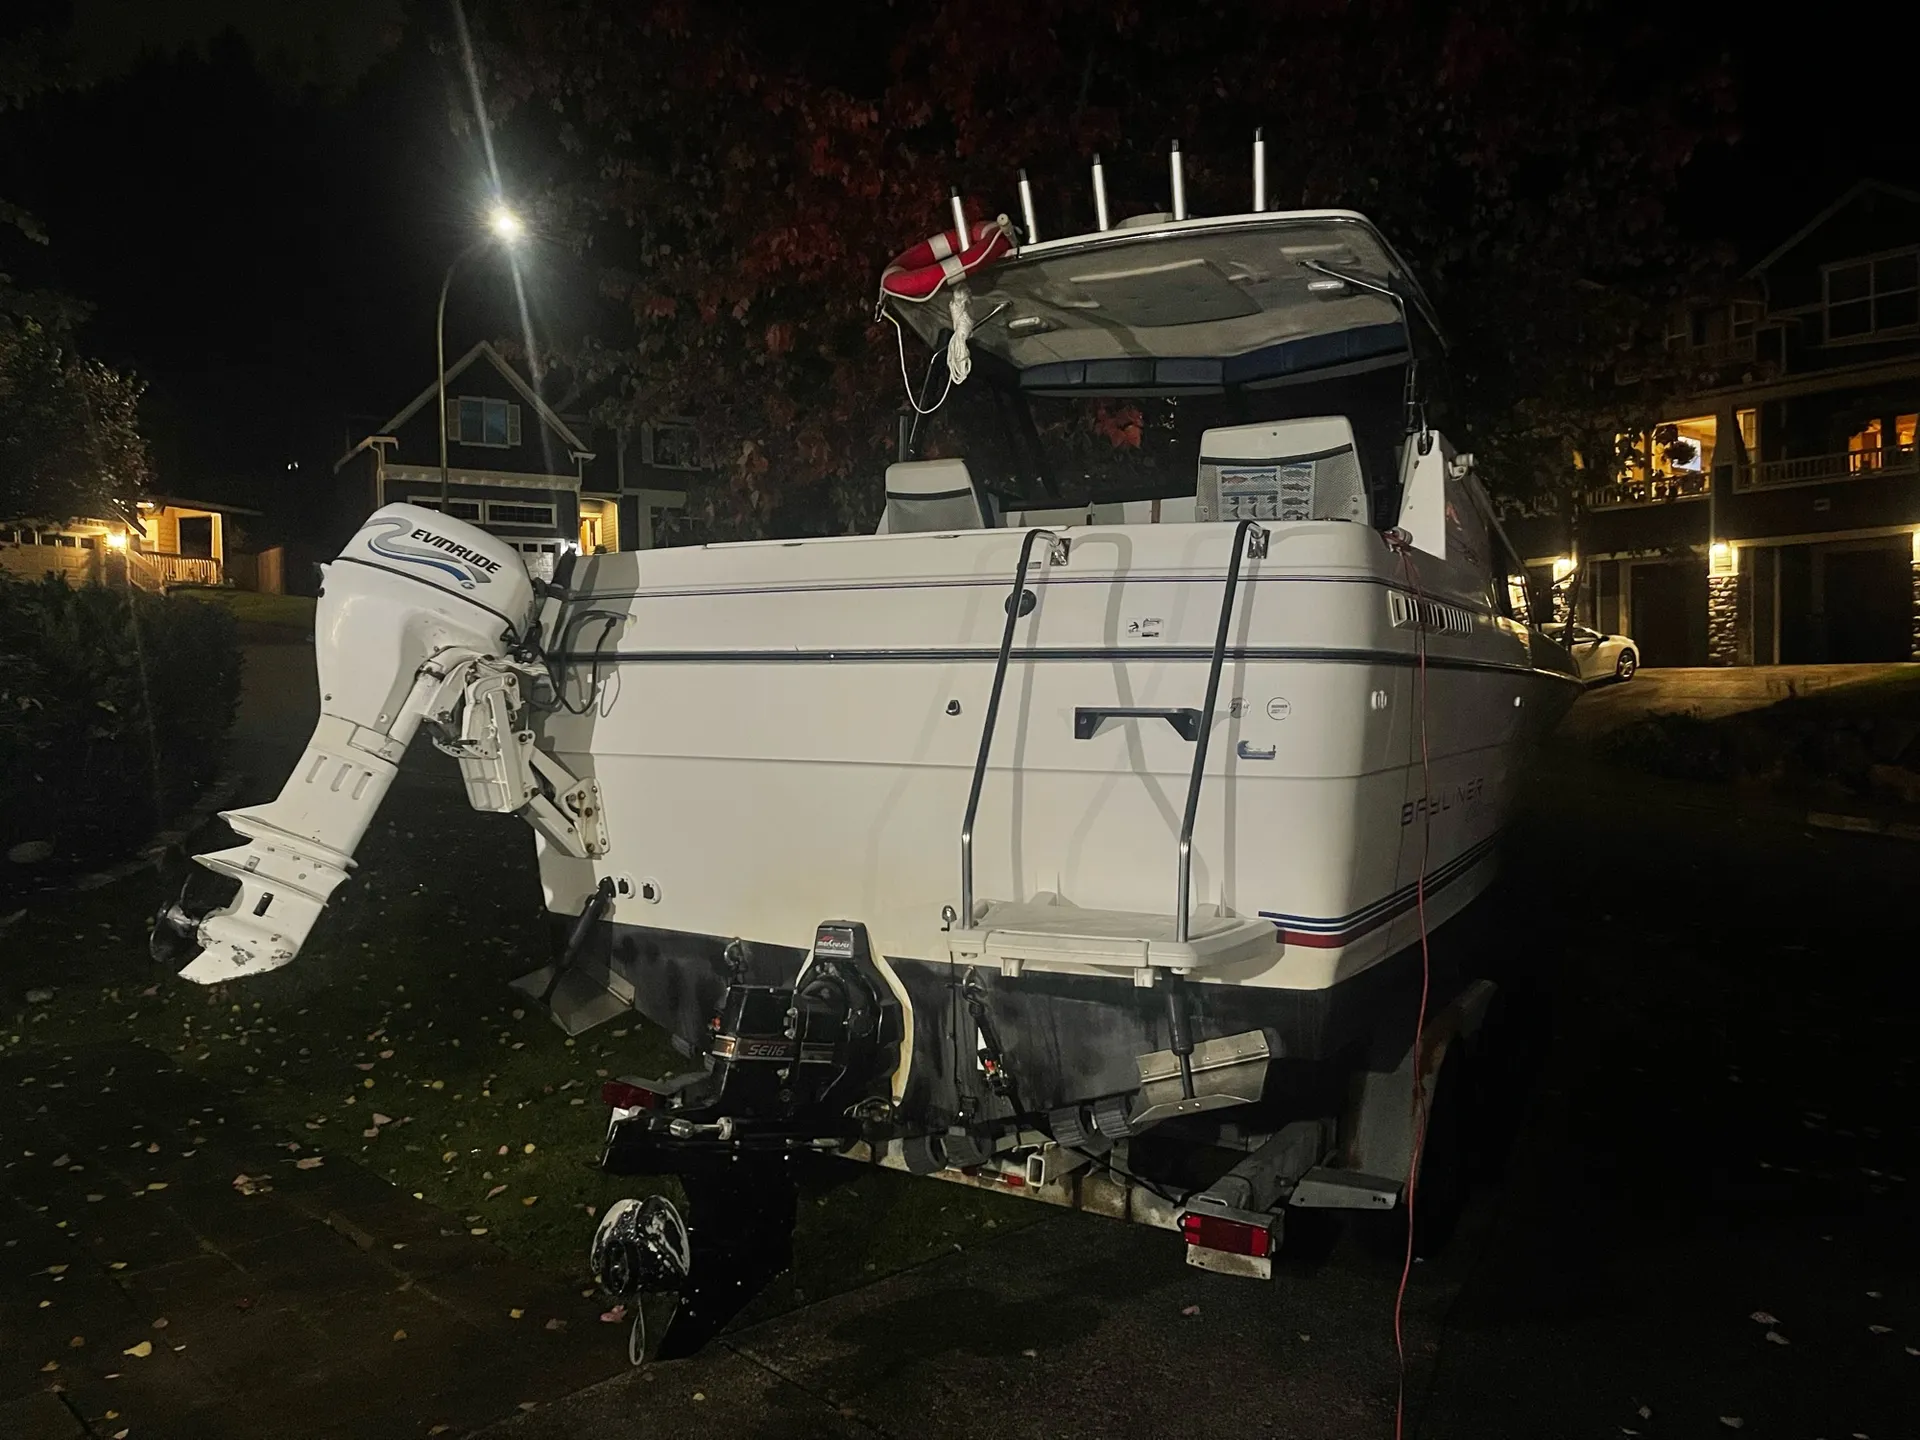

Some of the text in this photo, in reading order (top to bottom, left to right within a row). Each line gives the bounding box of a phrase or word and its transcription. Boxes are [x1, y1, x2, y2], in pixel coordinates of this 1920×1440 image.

[411, 528, 502, 574] EVINRUDE
[1401, 775, 1484, 827] BAYLINER
[747, 1044, 786, 1056] SE116
